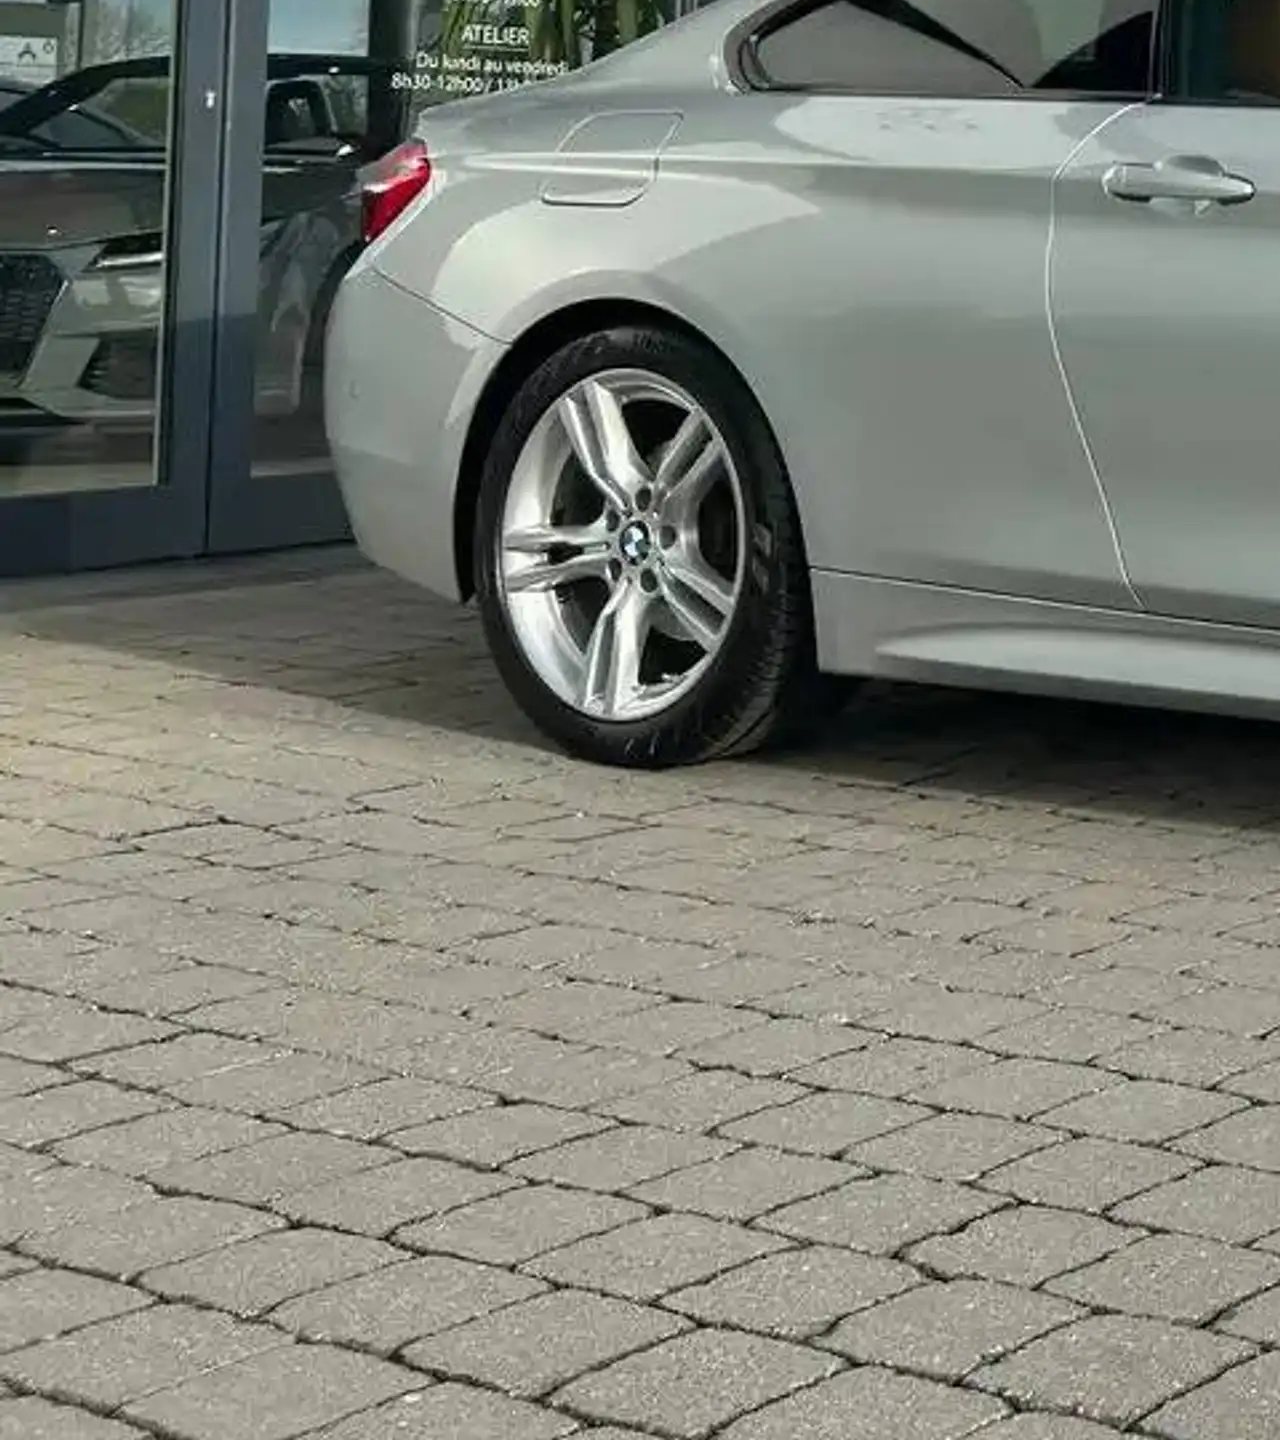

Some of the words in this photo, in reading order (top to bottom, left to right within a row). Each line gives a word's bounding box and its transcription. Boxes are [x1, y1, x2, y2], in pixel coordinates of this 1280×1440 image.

[461, 24, 530, 45] ATELIER
[415, 51, 439, 68] Du
[443, 53, 480, 70] lundi
[483, 61, 502, 73] au
